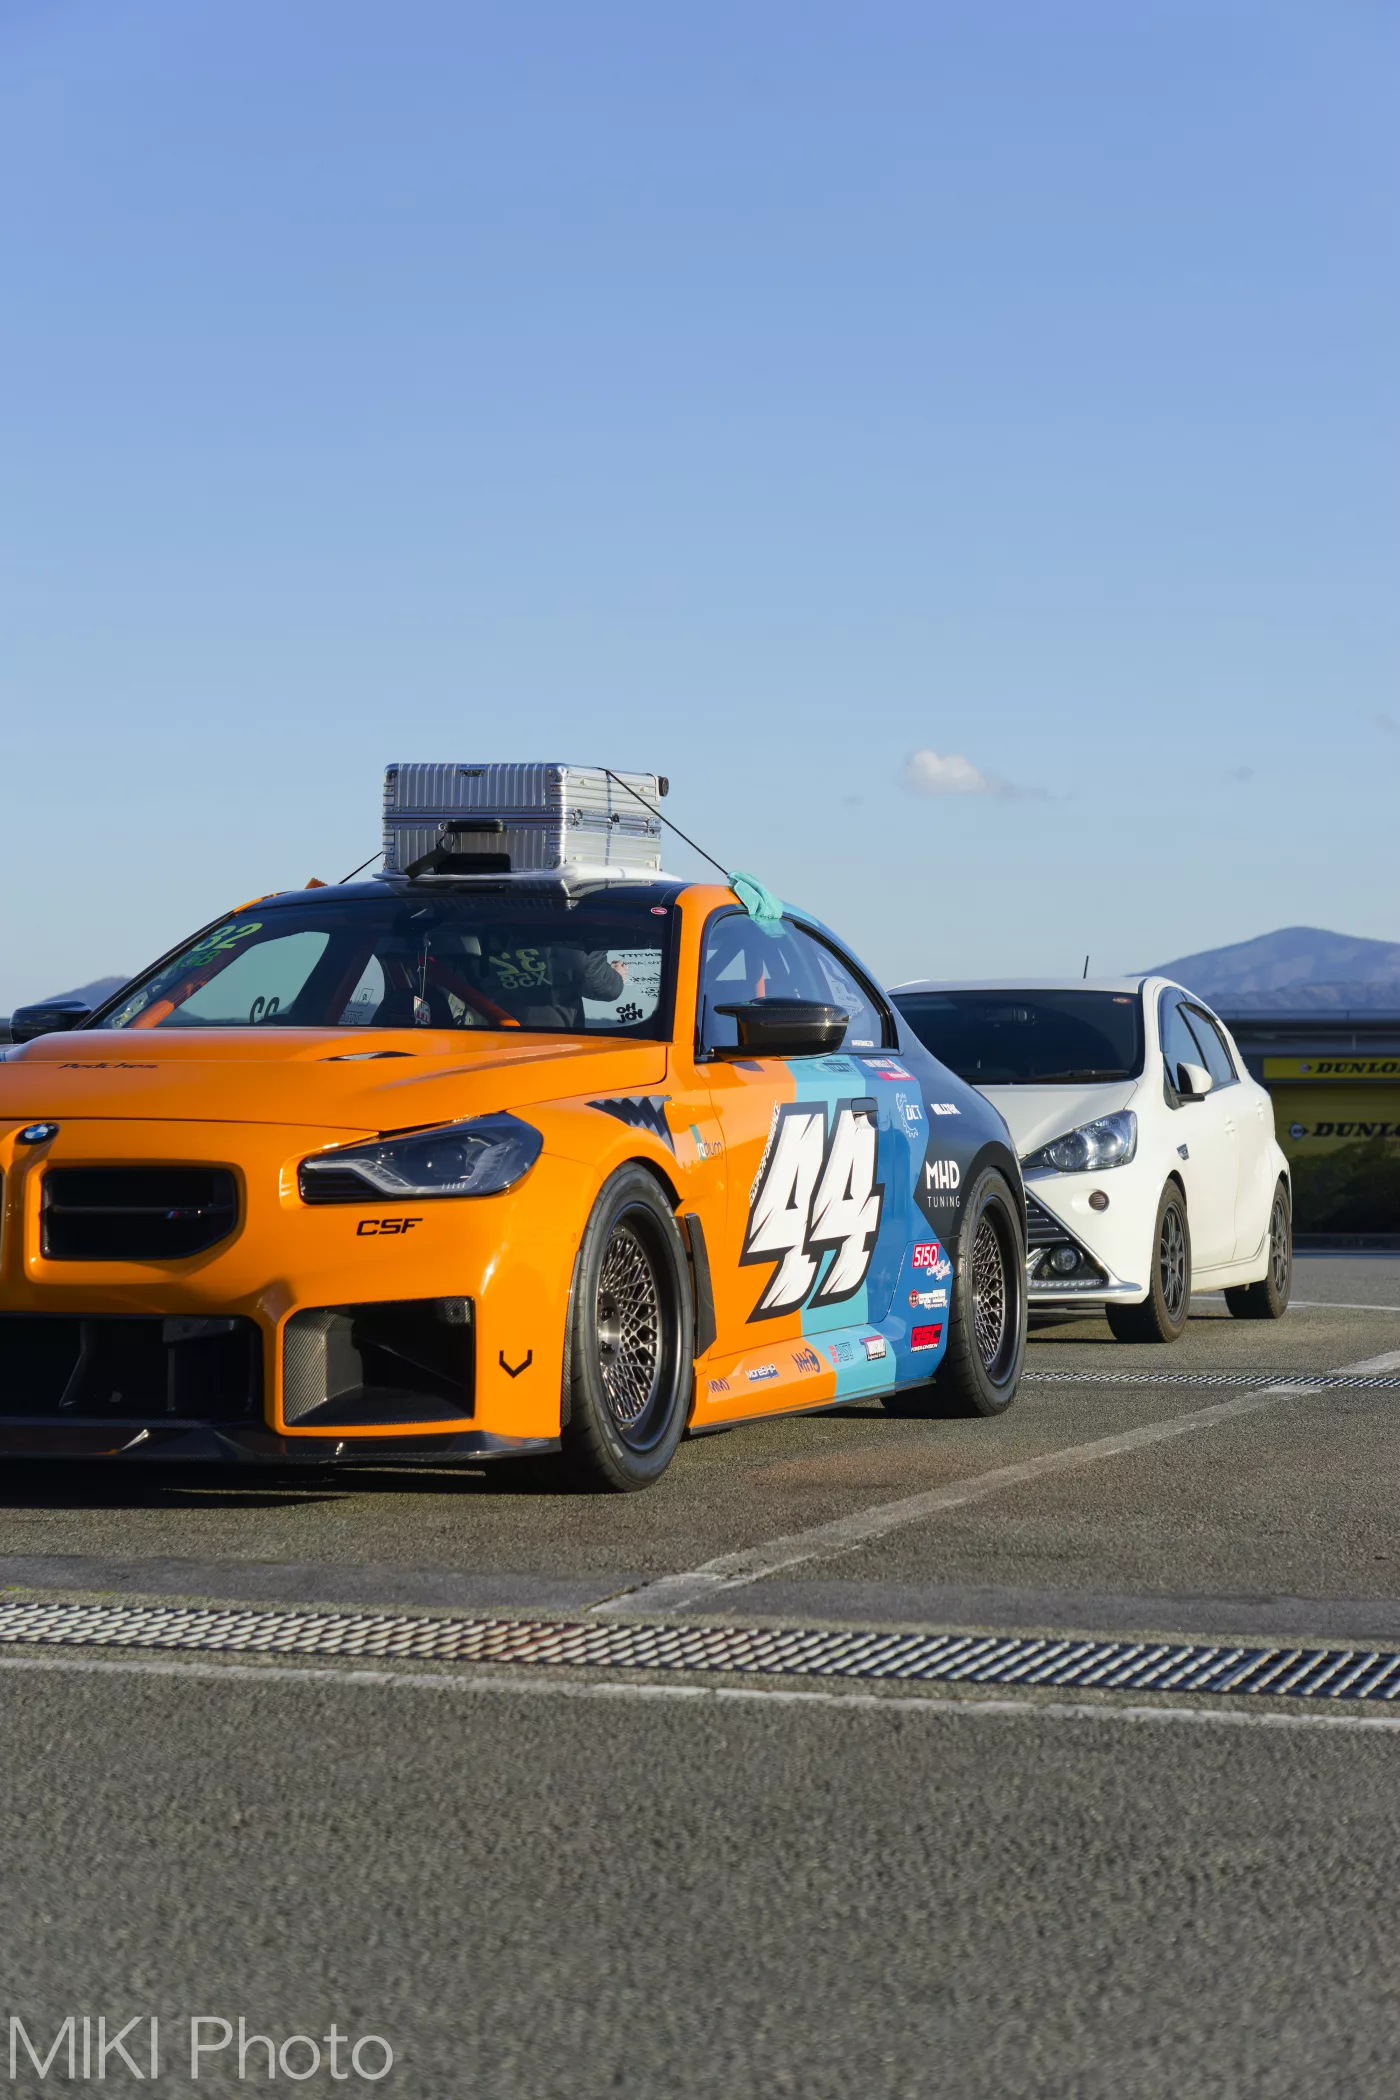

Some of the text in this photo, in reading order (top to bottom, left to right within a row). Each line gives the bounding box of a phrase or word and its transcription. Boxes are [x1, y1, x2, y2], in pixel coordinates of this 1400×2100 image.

[190, 922, 263, 952] 32
[1315, 1062, 1400, 1074] DUNLO
[905, 1104, 922, 1121] DCT
[925, 1160, 960, 1189] MHD
[738, 1098, 885, 1324] 44
[927, 1195, 960, 1208] TUNING
[356, 1217, 424, 1236] CSF
[913, 1245, 938, 1267] 5150
[911, 1323, 943, 1347] GSC
